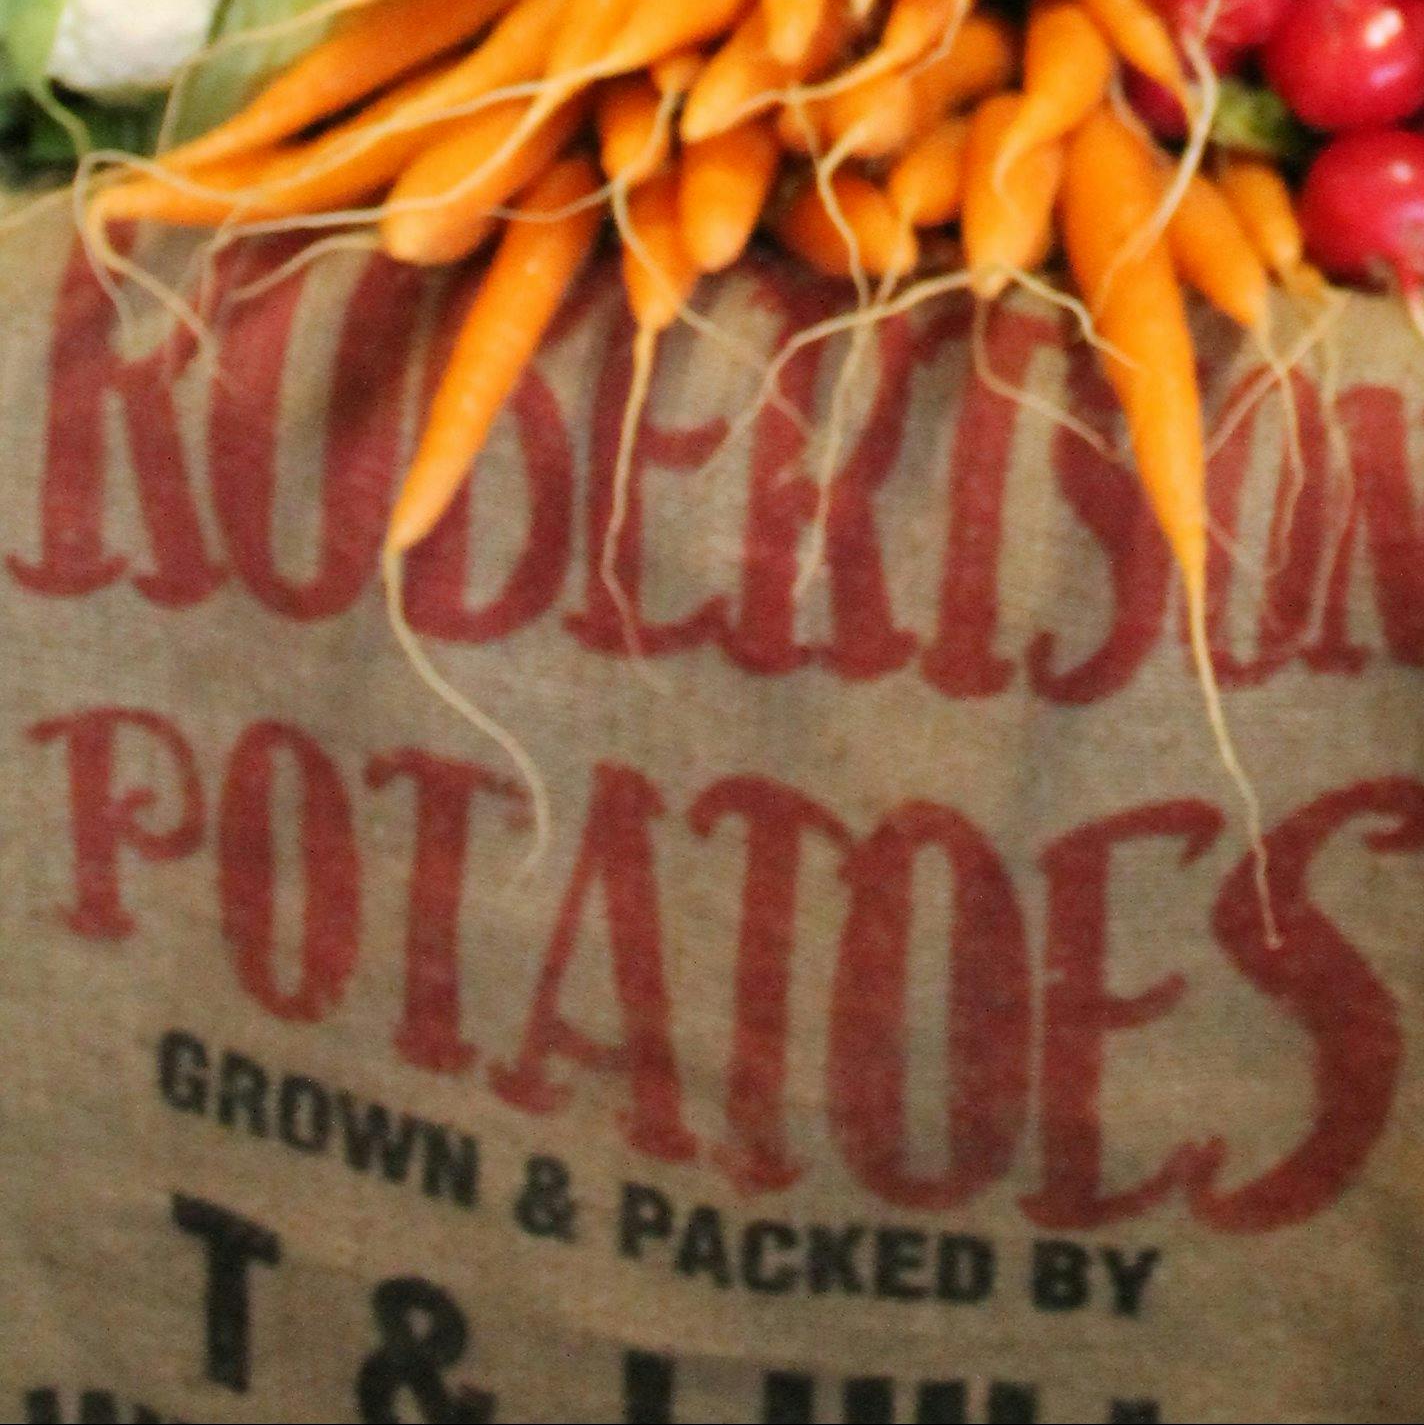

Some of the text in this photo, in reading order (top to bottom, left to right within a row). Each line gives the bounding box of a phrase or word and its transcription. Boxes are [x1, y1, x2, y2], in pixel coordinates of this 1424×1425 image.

[156, 1029, 1162, 1319] GROWN & PACKED BY
[171, 1191, 281, 1394] T
